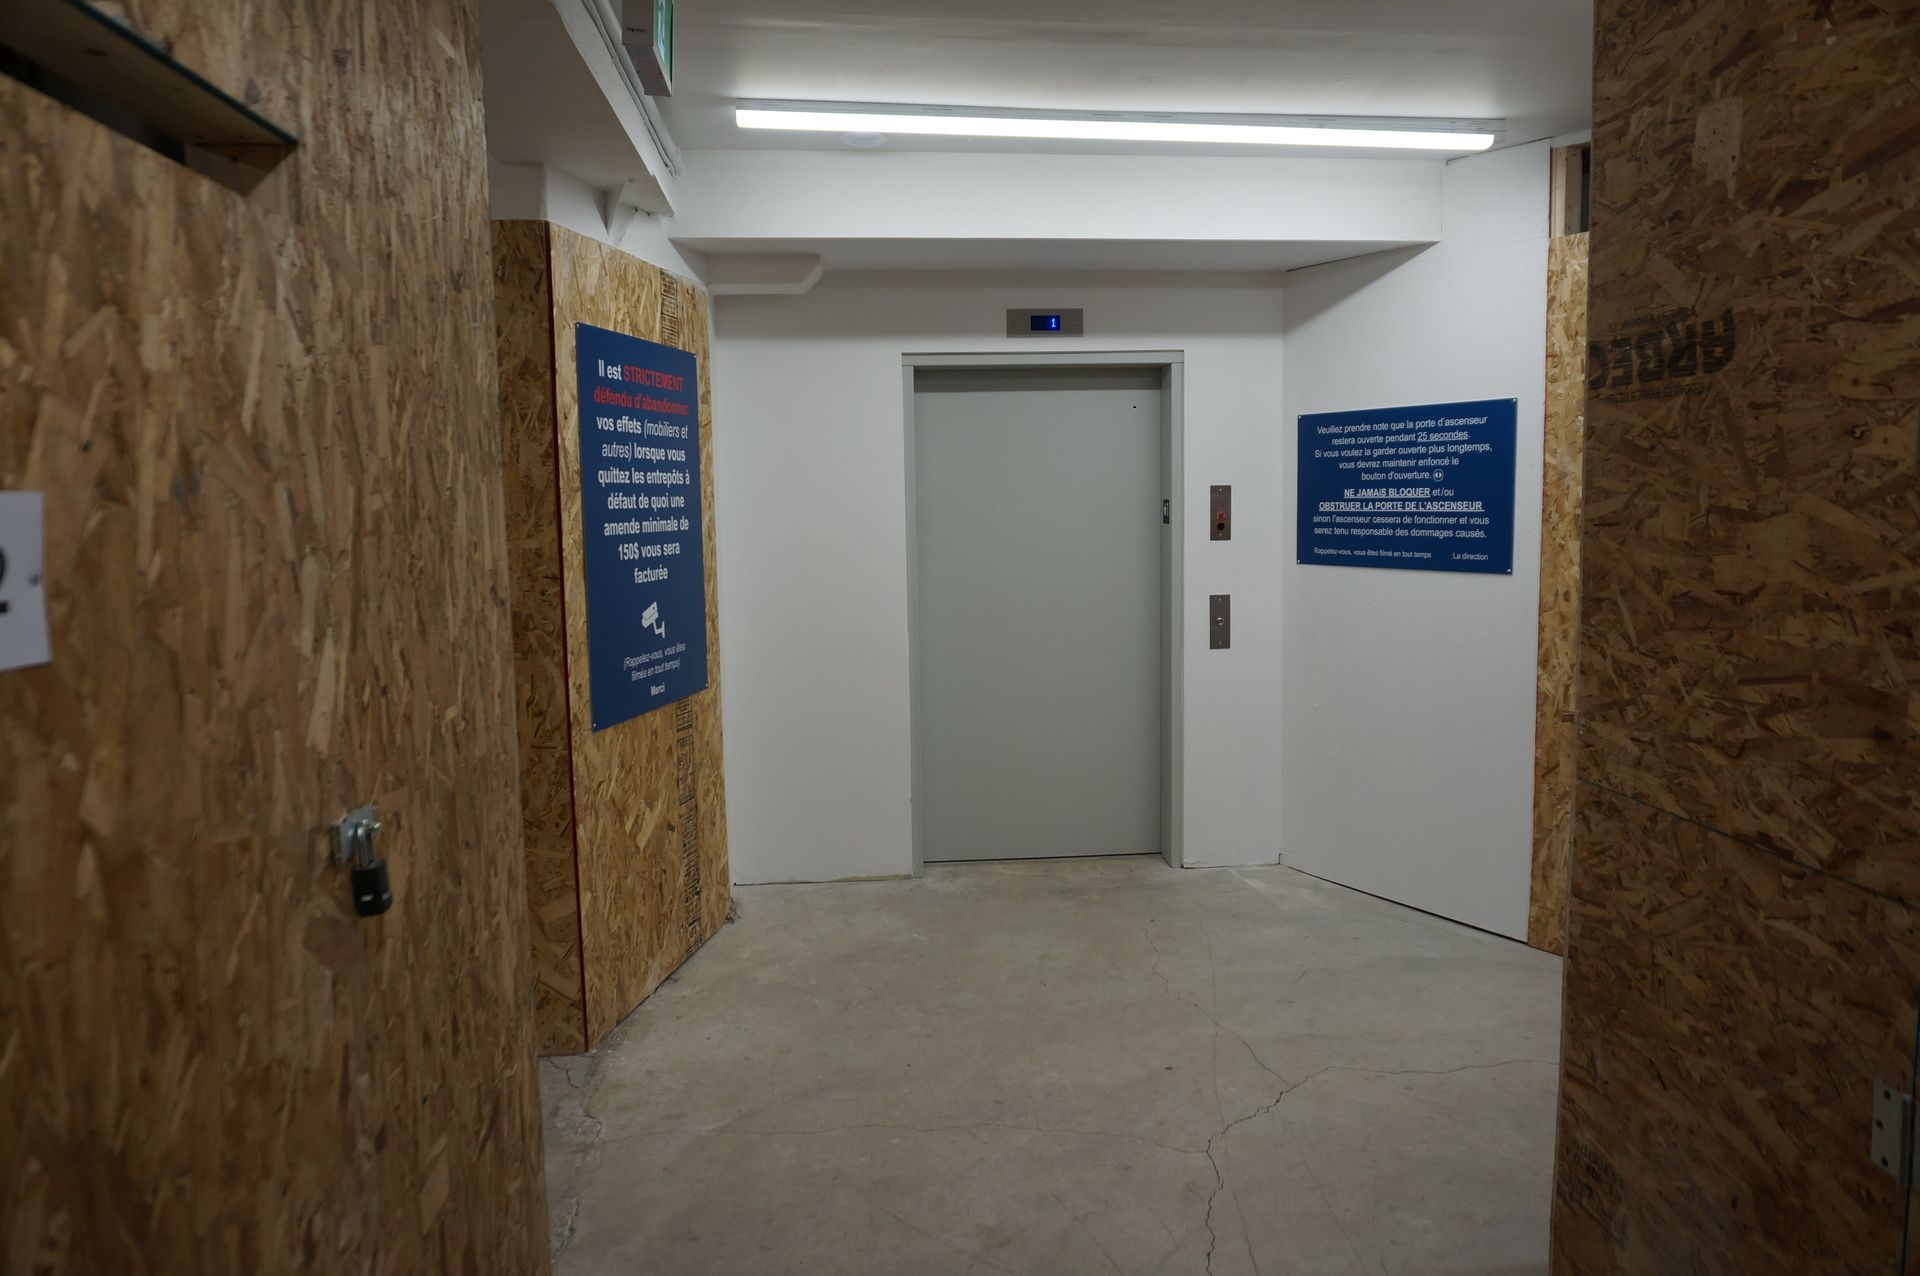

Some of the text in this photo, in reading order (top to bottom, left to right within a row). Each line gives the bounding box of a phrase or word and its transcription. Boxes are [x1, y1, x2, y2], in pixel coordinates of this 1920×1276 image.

[1051, 317, 1056, 328] 1
[598, 359, 683, 391] Il est STRICTEMENT
[594, 386, 689, 416] défendu d'abandonner
[596, 415, 689, 439] vos effets (mobiliers et
[1316, 415, 1489, 435] Veuillez prendre note que la porte d'ascenseur
[1331, 429, 1472, 446] restera ouverte pendant 25 secondes.
[601, 441, 686, 463] autres) lorsque vous
[1314, 442, 1493, 458] Si vous voulez la garder ouverte plus longtemps,
[1338, 456, 1460, 469] vous devrez maintenir enfoncé le
[597, 466, 690, 488] quittez les entrepôts à
[1361, 470, 1433, 481] bouton d'ouverture.
[1344, 488, 1356, 498] NE
[1388, 487, 1431, 498] BLOQUER
[607, 491, 685, 512] défaut de quoi une
[1319, 501, 1483, 511] OBSTRUER LA PORTE DE L'ASCENSEUR
[603, 515, 690, 536] amende minimale de
[1312, 514, 1490, 525] sinon l'ascenseur cessera de fonctionner et vous
[1314, 526, 1488, 539] serez tenu responsable des dommages causés.
[618, 541, 681, 561] 150$ vous sera
[1401, 550, 1414, 558] tout
[1413, 551, 1433, 559] temps
[1452, 551, 1489, 560] La direction
[633, 564, 669, 584] facturée
[664, 646, 676, 656] vous
[655, 663, 664, 674] tout
[650, 682, 665, 696] Merci
